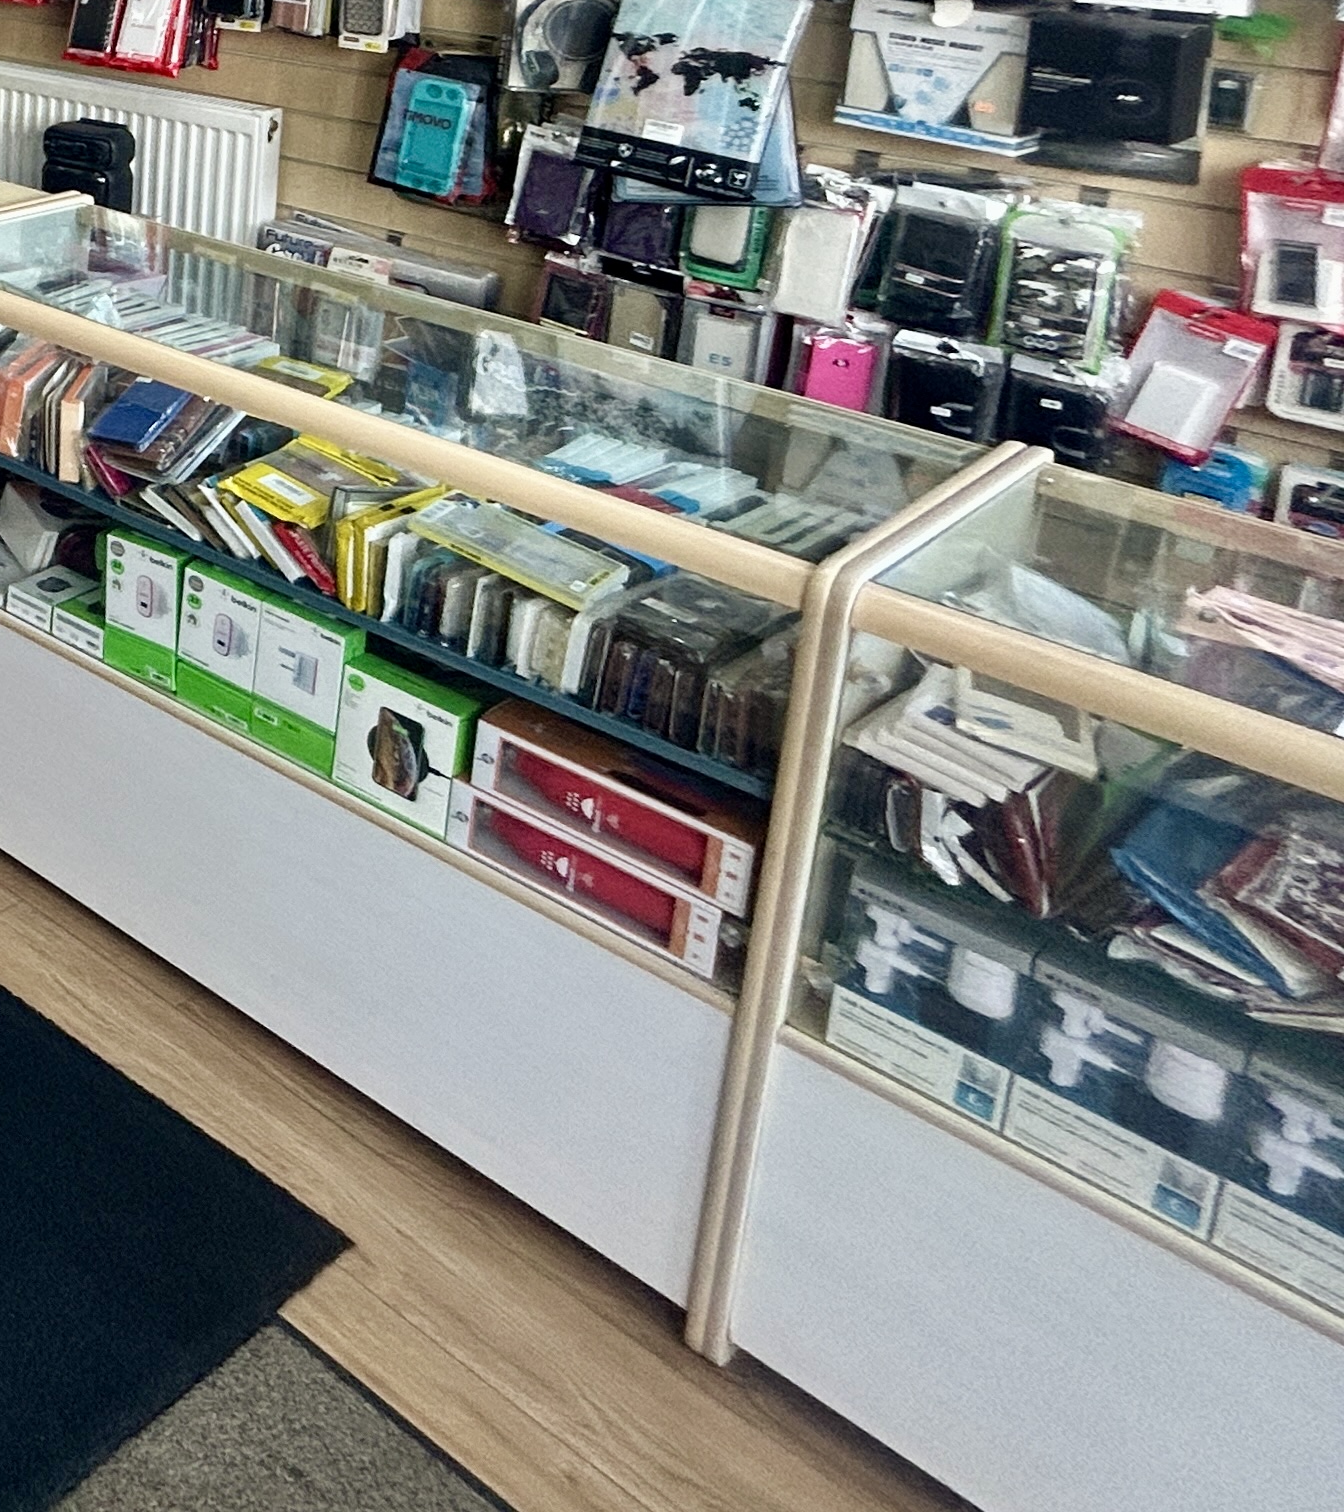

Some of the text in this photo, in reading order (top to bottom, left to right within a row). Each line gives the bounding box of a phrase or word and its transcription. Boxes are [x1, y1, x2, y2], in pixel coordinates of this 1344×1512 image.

[709, 352, 732, 367] E5
[149, 555, 174, 570] belkin
[231, 595, 257, 613] belkin
